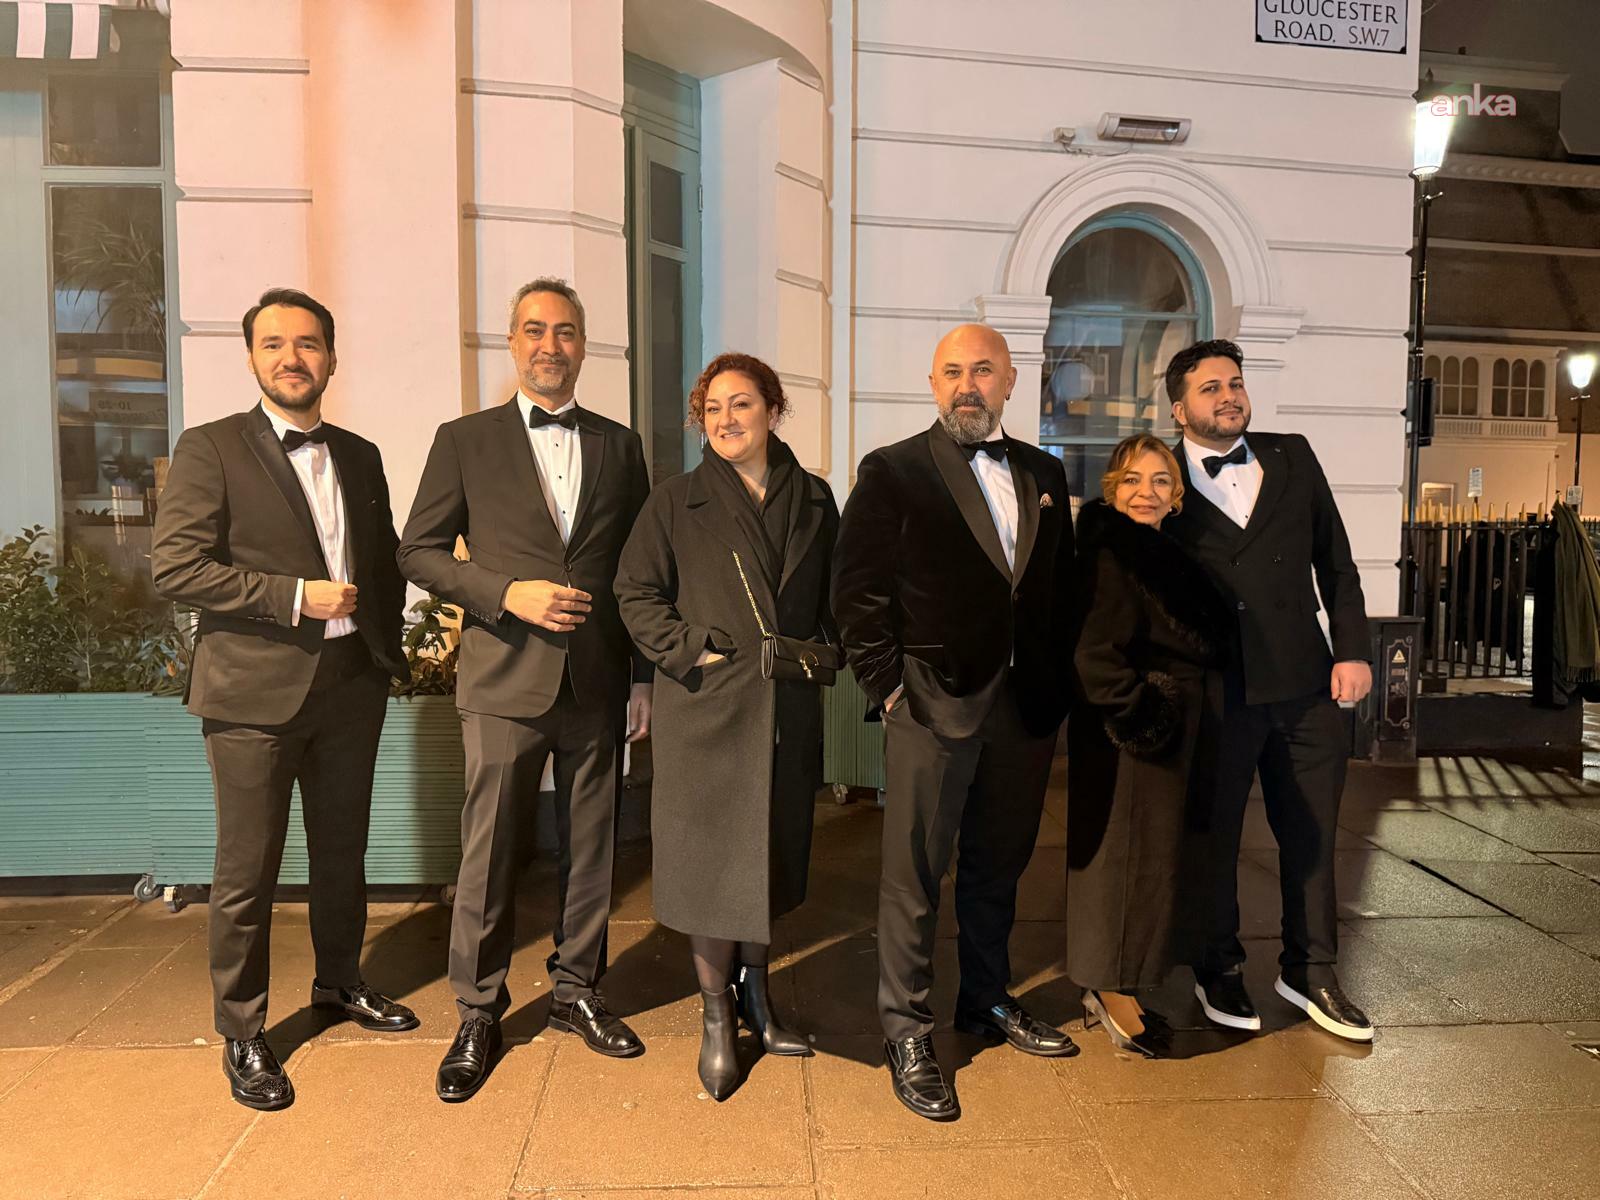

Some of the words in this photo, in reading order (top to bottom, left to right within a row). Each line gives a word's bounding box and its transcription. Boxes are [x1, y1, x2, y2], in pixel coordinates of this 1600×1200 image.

[1264, 0, 1398, 24] GLOUCESTER
[1274, 20, 1336, 43] ROAD.
[1348, 26, 1390, 46] S.W.7
